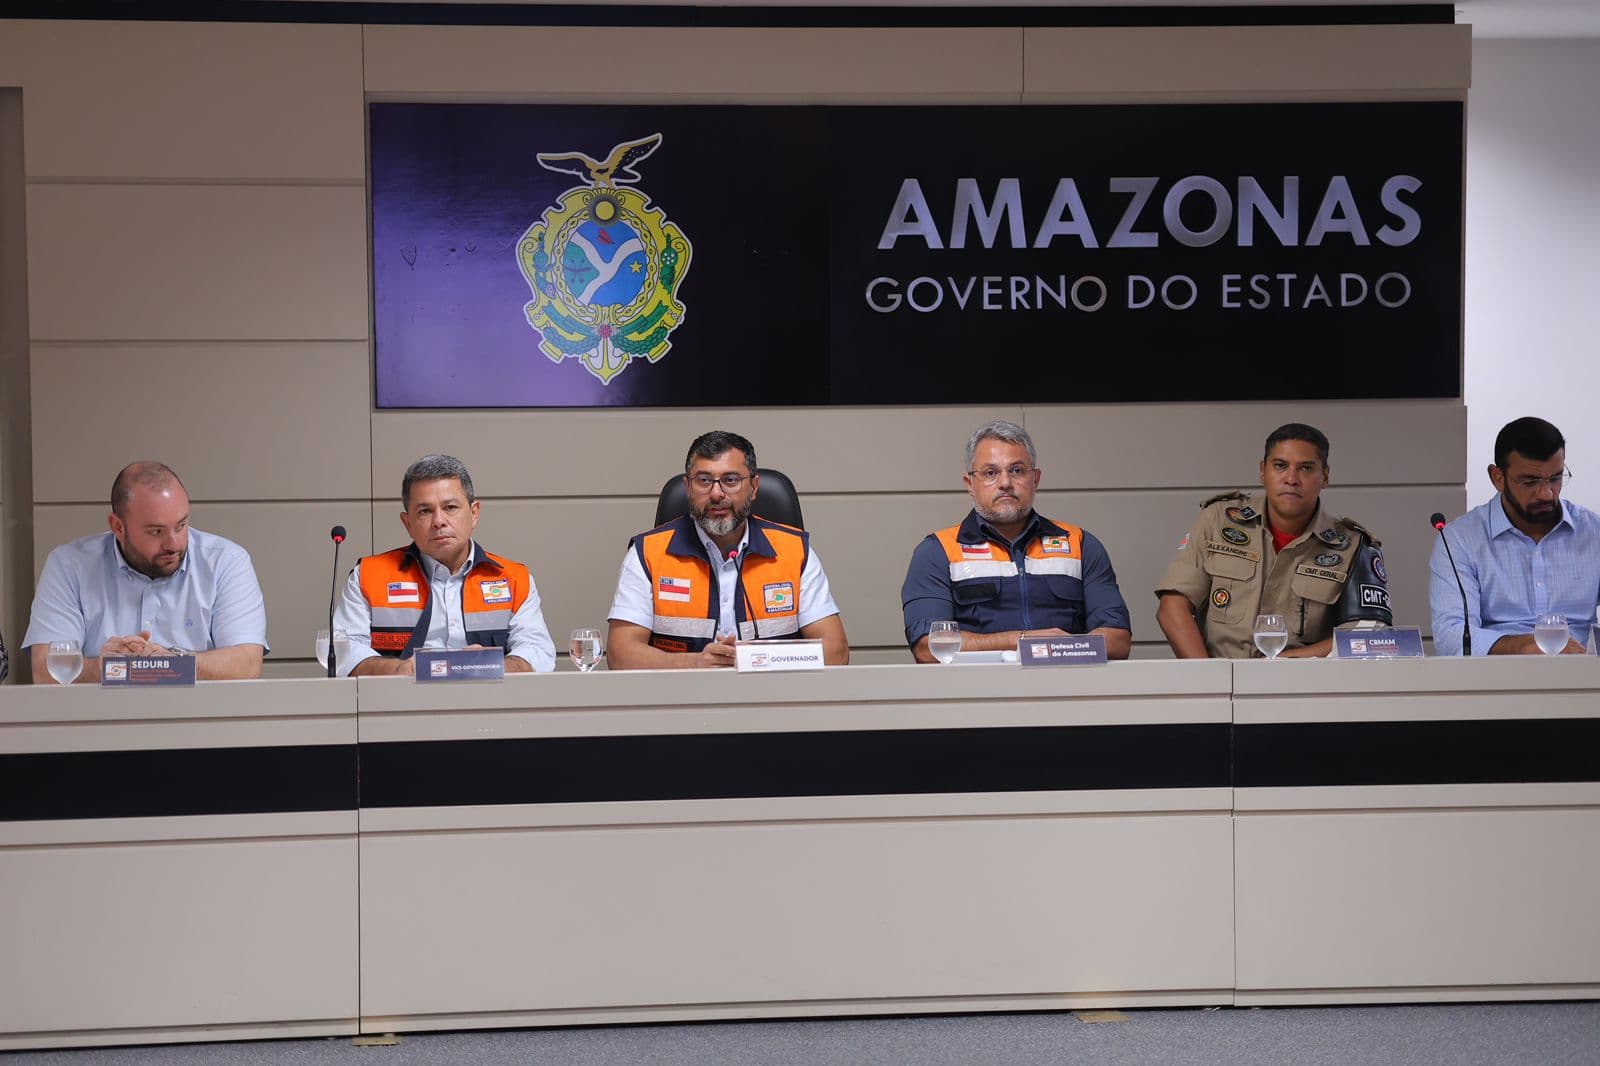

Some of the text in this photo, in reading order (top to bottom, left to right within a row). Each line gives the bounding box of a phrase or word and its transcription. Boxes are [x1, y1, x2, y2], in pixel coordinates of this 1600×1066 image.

[877, 174, 1422, 249] AMAZONAS
[865, 271, 1412, 313] GOVERNO DO ESTADO
[1208, 543, 1248, 557] ALEXANDRE
[131, 660, 170, 669] SEDURB
[771, 655, 819, 663] GOVERNADOR
